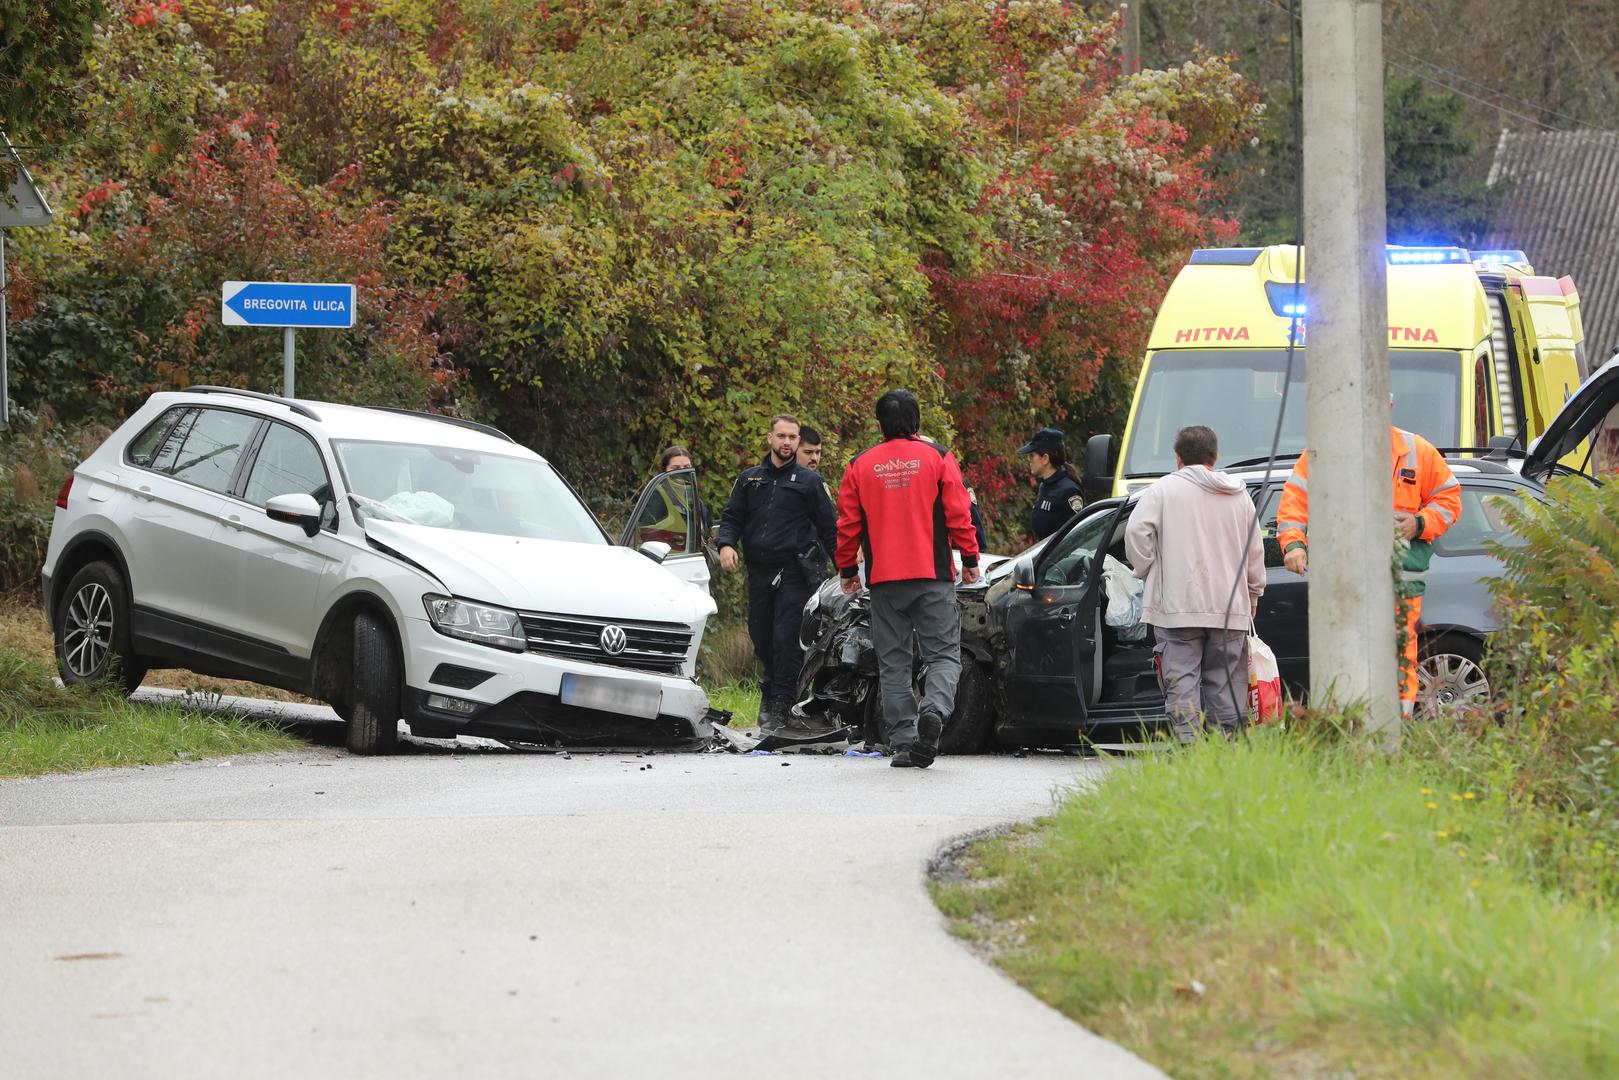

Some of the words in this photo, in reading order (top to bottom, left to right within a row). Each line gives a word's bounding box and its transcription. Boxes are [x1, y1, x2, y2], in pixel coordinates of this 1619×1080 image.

[243, 298, 308, 311] BREGOVITA
[313, 300, 345, 312] ULICA
[1175, 326, 1250, 343] HITNA
[1387, 326, 1438, 343] TNA
